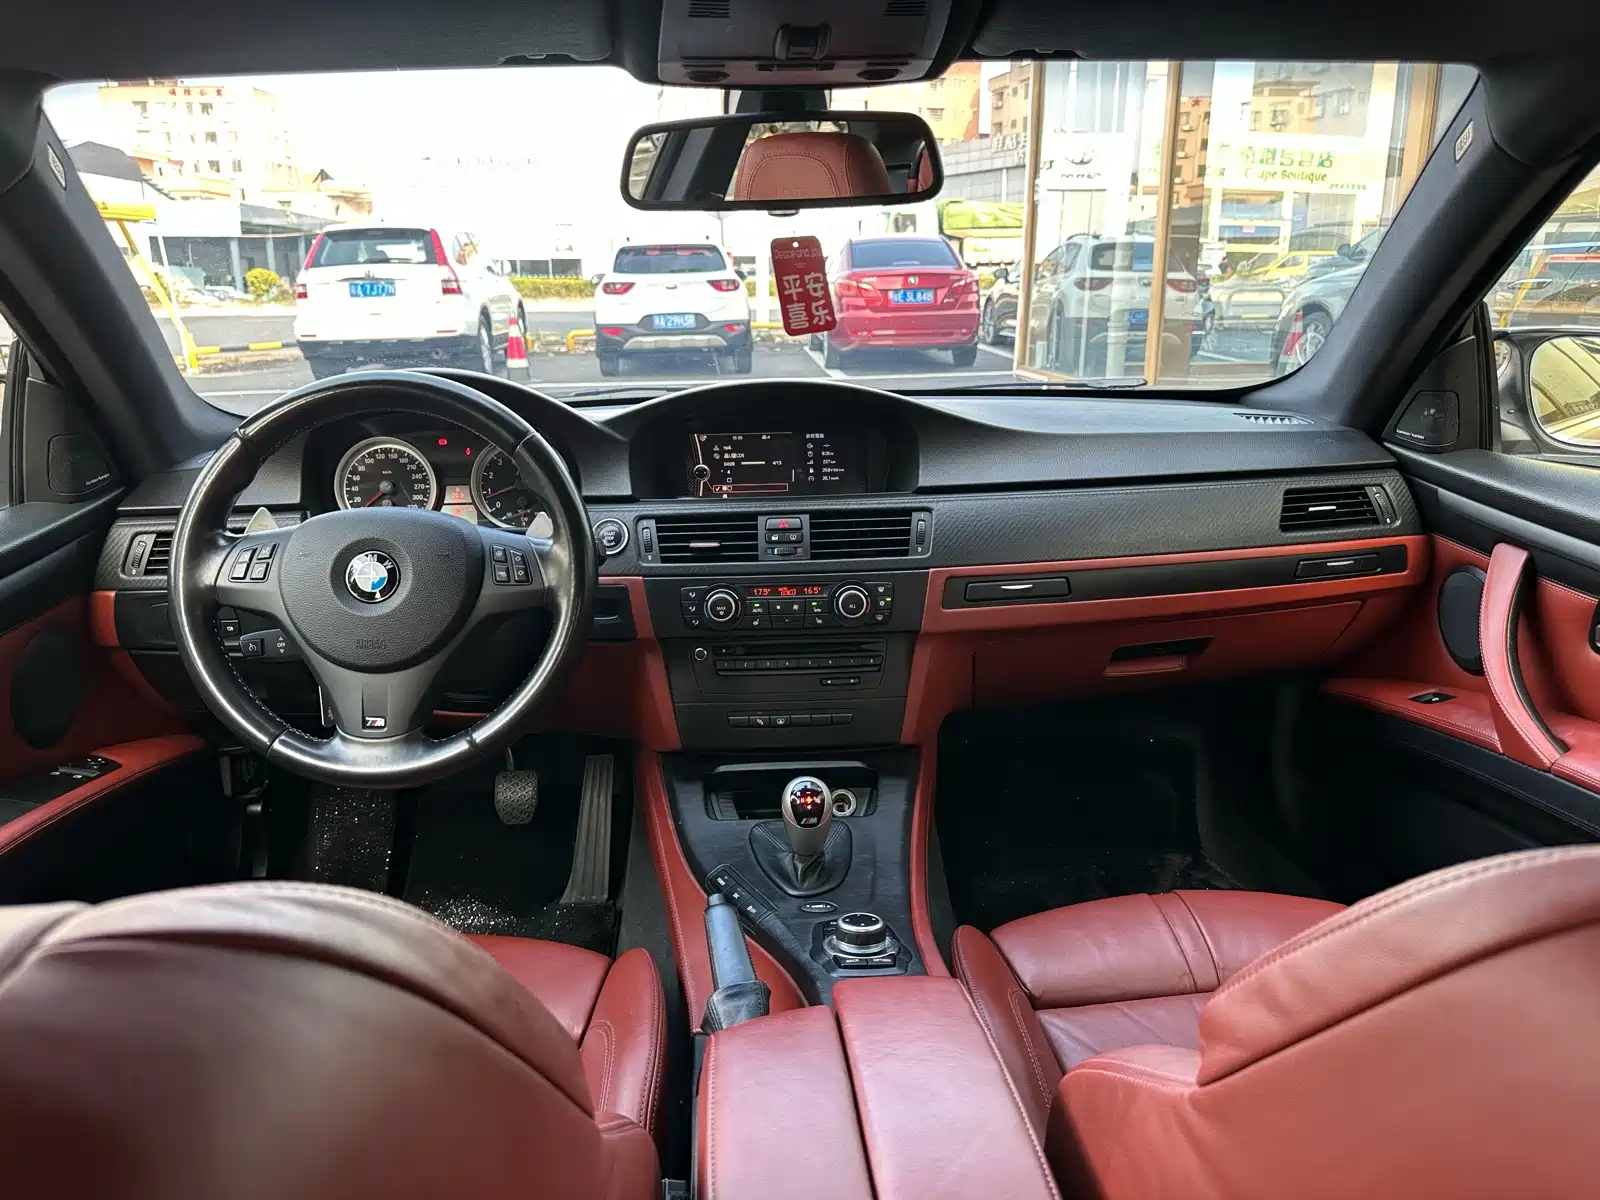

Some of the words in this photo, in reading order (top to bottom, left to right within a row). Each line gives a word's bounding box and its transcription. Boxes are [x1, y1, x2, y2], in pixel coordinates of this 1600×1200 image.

[782, 271, 825, 300] 平安
[786, 299, 832, 330] 喜乐
[497, 458, 503, 466] 3
[495, 501, 501, 509] 0
